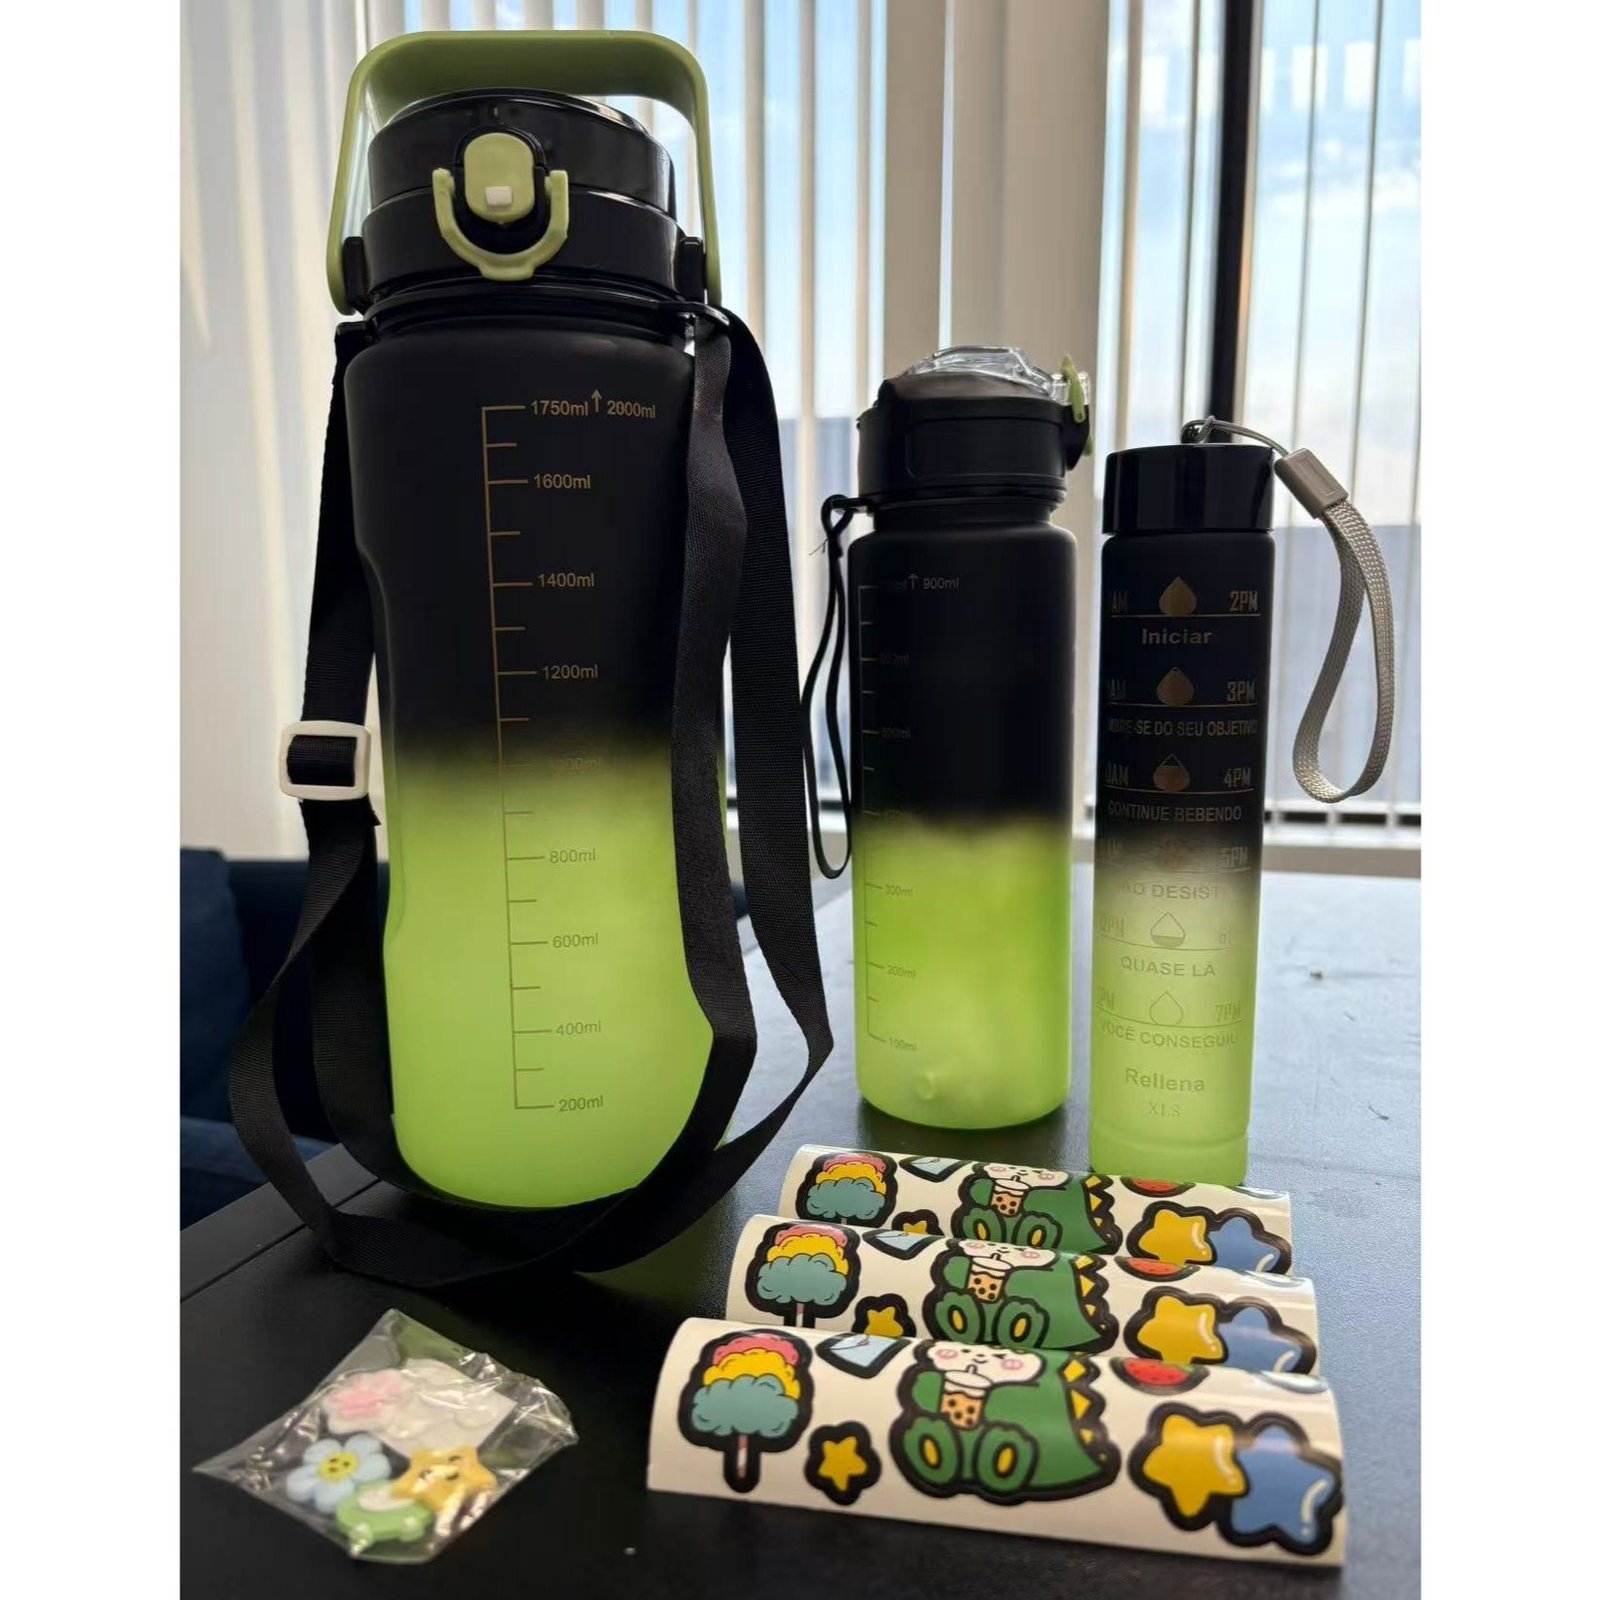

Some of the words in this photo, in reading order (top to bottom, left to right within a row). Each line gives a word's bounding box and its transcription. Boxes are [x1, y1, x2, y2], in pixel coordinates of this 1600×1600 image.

[531, 399, 589, 417] 1750ml
[606, 400, 656, 419] 2000ml
[533, 473, 591, 490] 1600ml
[537, 572, 595, 588] 1400ml
[922, 576, 960, 591] 900ml
[1229, 590, 1259, 612] 2PM
[1141, 628, 1213, 645] Iniciar
[542, 664, 599, 680] 1200ml
[1226, 681, 1256, 702] 3PM
[1154, 720, 1173, 736] DO
[1176, 721, 1204, 737] SEU
[1223, 766, 1252, 789] 4PM
[1107, 800, 1171, 822] CONTINUE
[1174, 805, 1243, 823] BEBENDO
[549, 848, 597, 864] 800ml
[552, 932, 600, 949] 600ml
[1120, 955, 1186, 977] QUASE
[555, 1019, 602, 1037] 400ml
[1125, 1066, 1206, 1092] Rellena
[558, 1094, 604, 1113] 200ml
